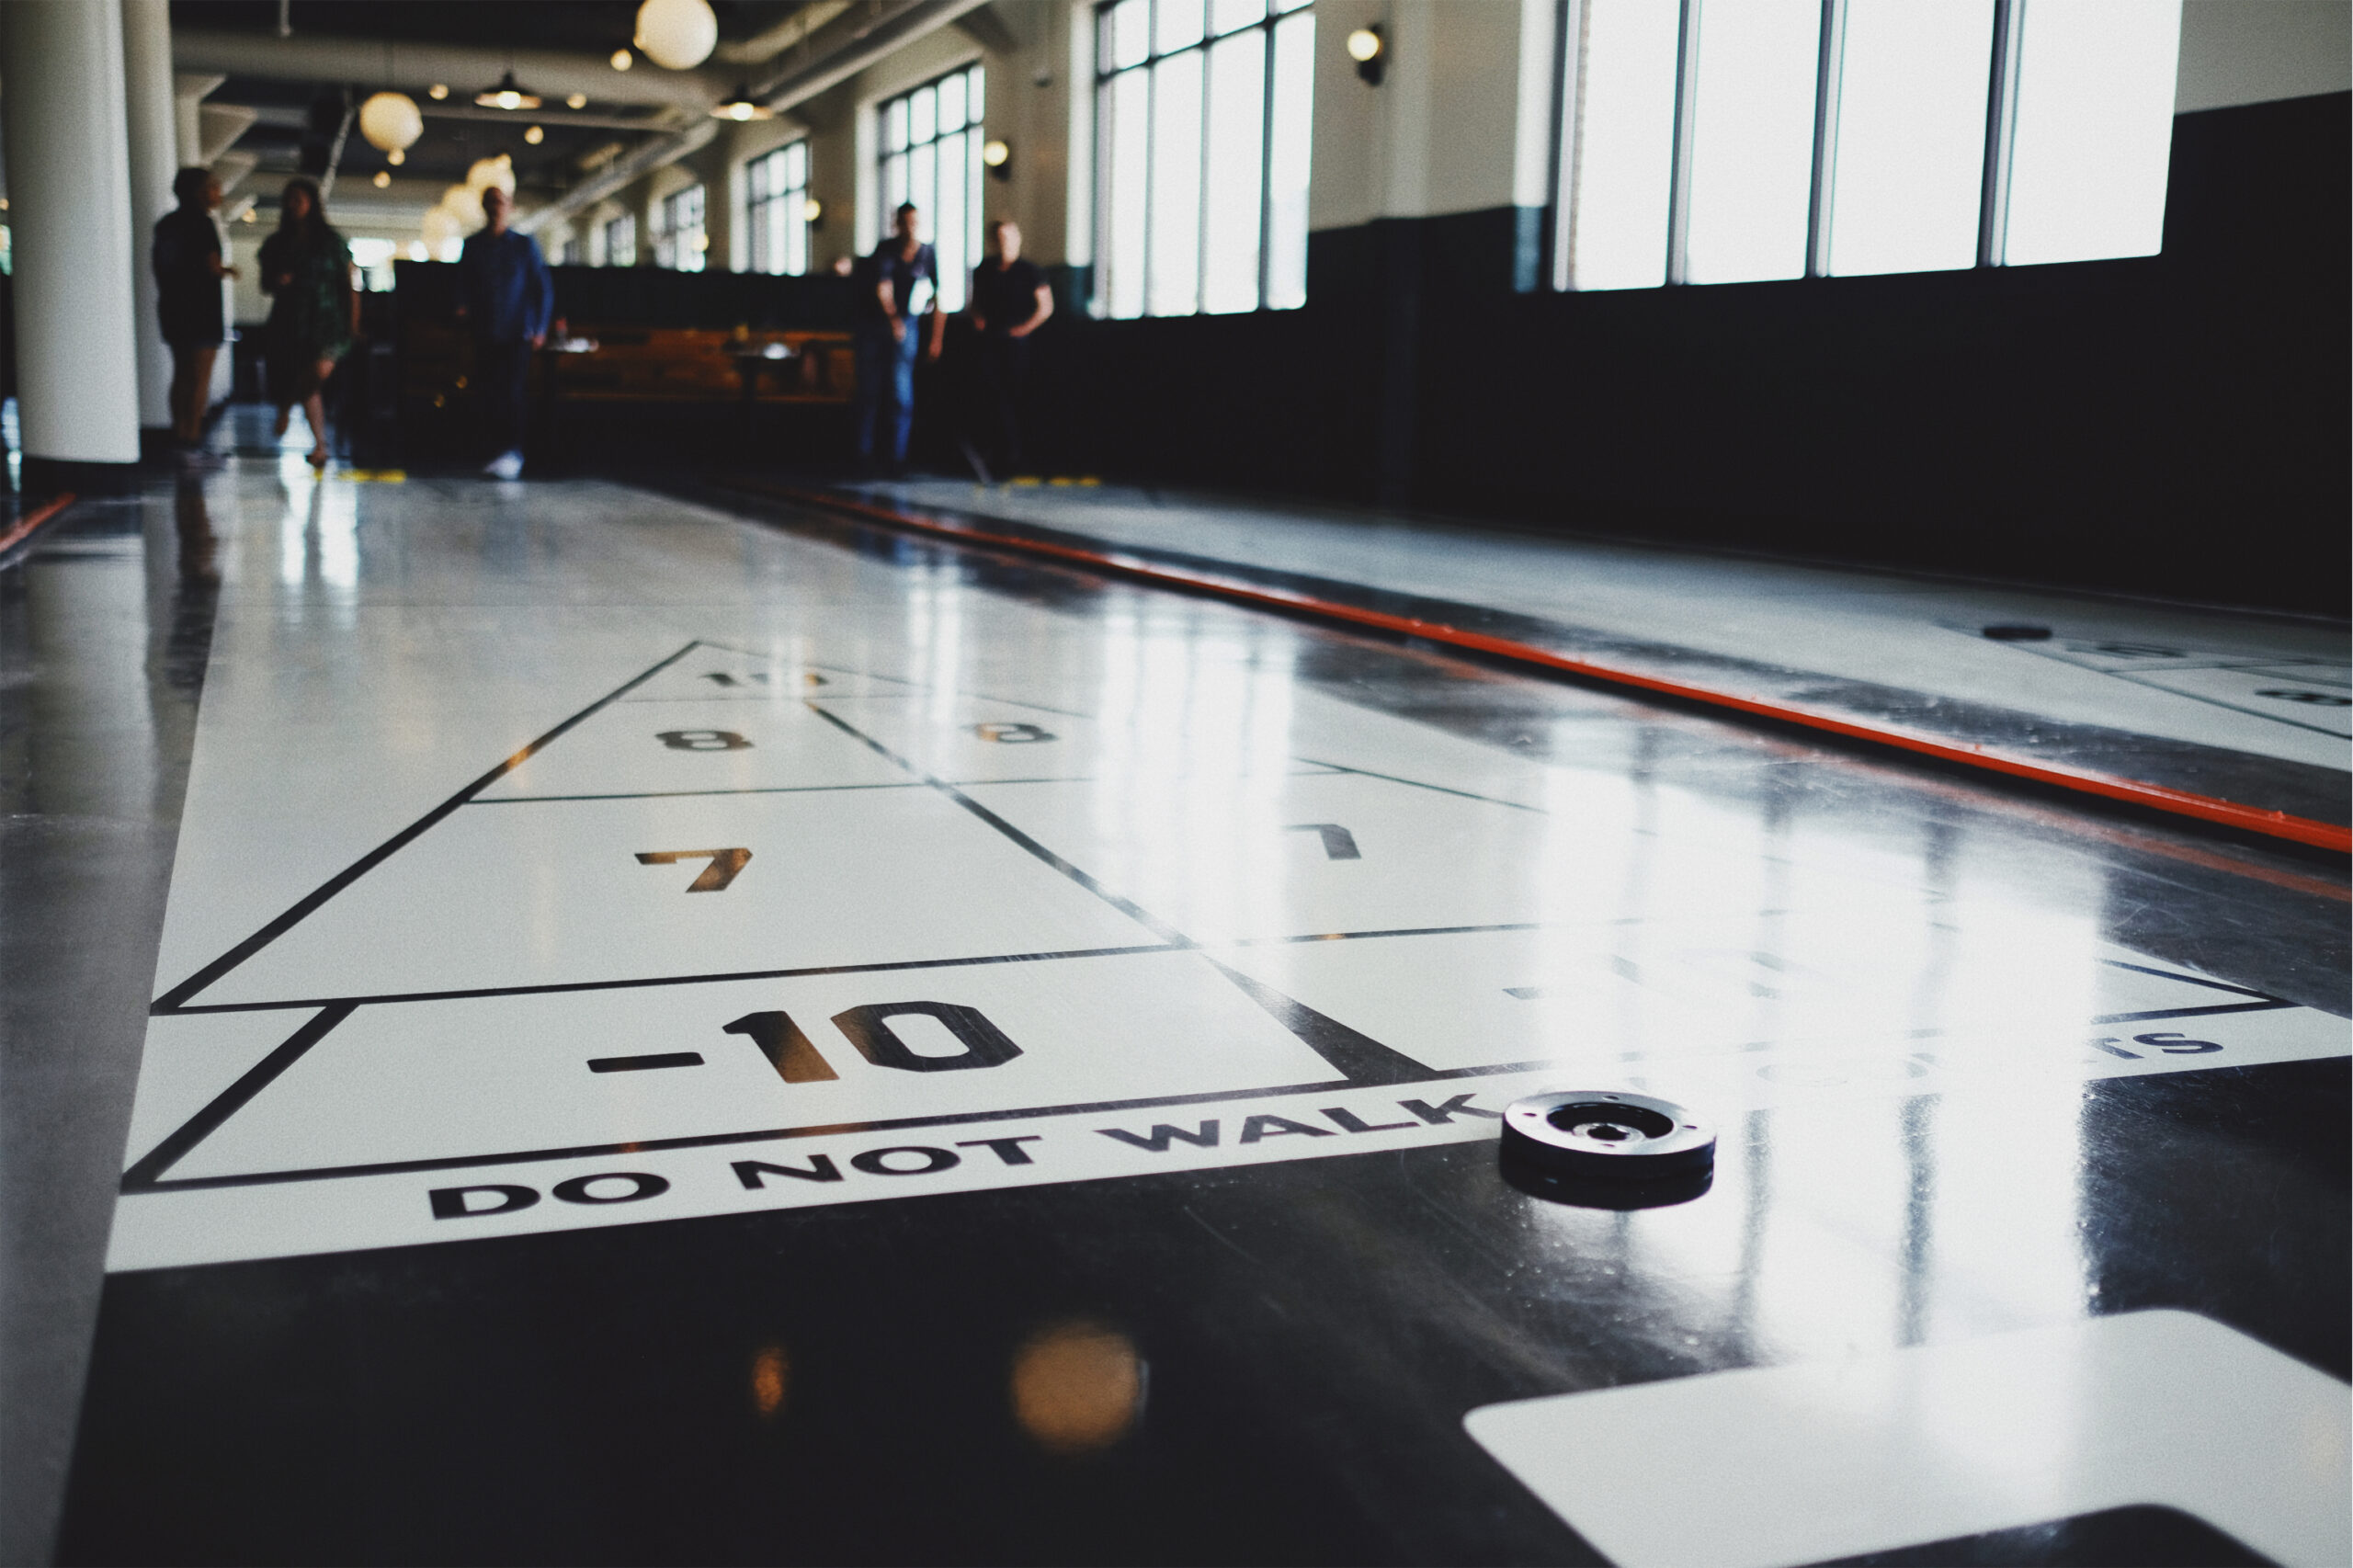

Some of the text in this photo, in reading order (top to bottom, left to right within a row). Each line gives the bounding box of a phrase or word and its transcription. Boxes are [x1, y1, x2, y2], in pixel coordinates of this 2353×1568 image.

[654, 729, 754, 752] 8
[634, 846, 754, 893] 7
[586, 999, 1025, 1085] -10
[427, 1092, 1507, 1221] DO NOT WALK
